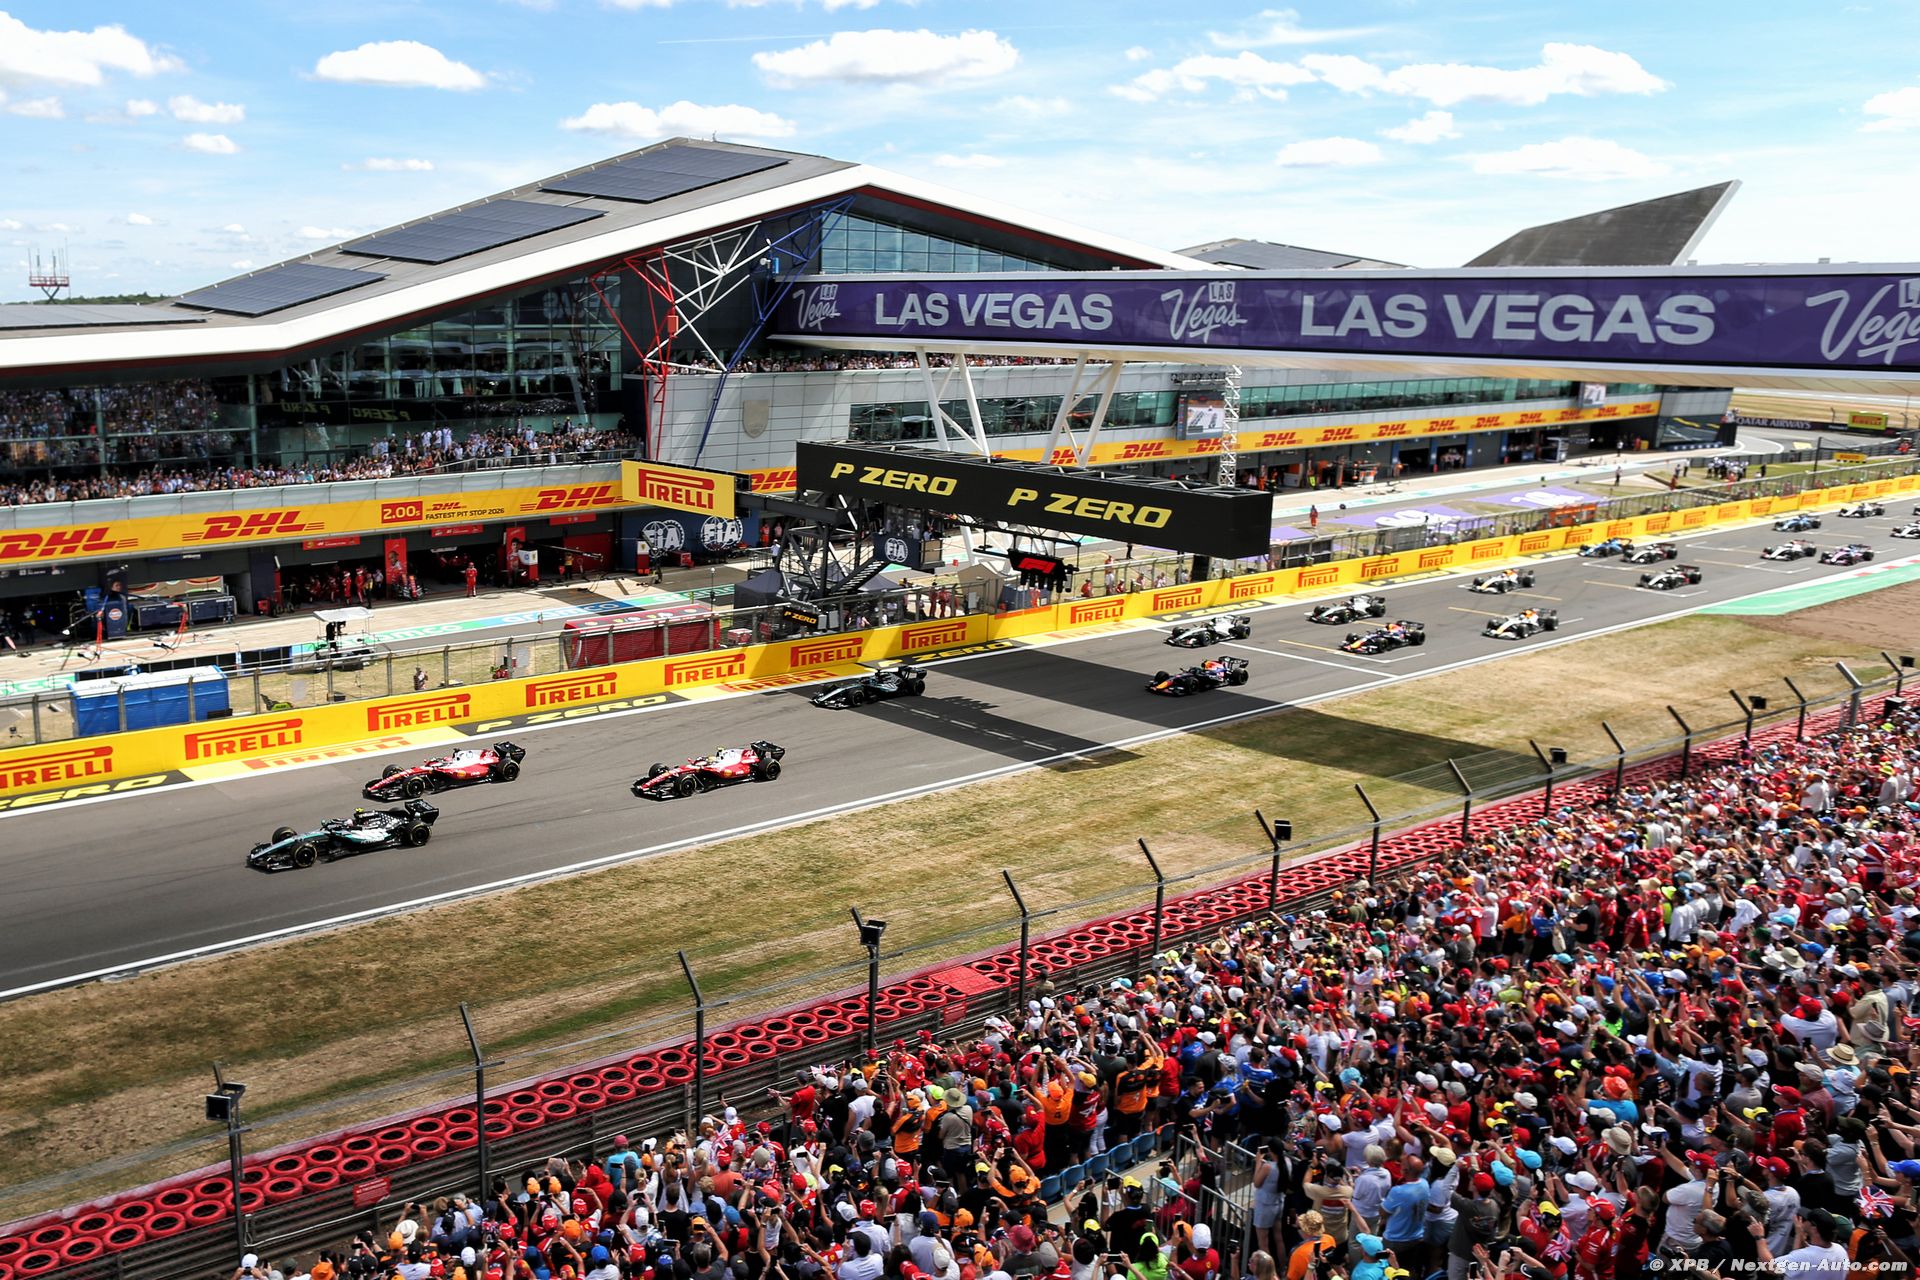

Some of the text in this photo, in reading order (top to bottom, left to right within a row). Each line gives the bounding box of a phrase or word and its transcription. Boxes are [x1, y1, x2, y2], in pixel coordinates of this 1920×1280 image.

[820, 284, 838, 300] LAS
[1209, 281, 1235, 302] LAS
[793, 285, 841, 331] Vegas
[876, 292, 1113, 330] LAS VEGAS
[1161, 286, 1248, 343] Vegas
[1300, 295, 1715, 345] LAS VEGAS
[1805, 284, 1920, 365] Veg
[1262, 432, 1297, 446] DHL
[1323, 428, 1354, 441] DHL
[1378, 424, 1407, 436] DHL
[1428, 420, 1456, 432] DHL
[1123, 442, 1166, 458] DHL
[638, 469, 715, 510] PIRELLI
[831, 463, 957, 496] P ZERO
[432, 502, 462, 510] DHL
[535, 486, 615, 510] DHL
[1007, 488, 1173, 528] P ZERO
[203, 511, 306, 539] DHL
[383, 506, 421, 520] 2.00s
[426, 511, 456, 520] FASTEST
[470, 509, 487, 517] STOP
[0, 527, 117, 558] DHL
[1361, 558, 1399, 577] PIRELLI
[1419, 550, 1454, 568] PIRELLI
[1229, 577, 1274, 599] PIRELLI
[1298, 567, 1339, 587] PIRELLI
[1070, 599, 1124, 624] PIRELLI
[1153, 588, 1202, 611] PIRELLI
[792, 613, 817, 624] ZERO
[902, 622, 967, 650] PIRELLI
[790, 637, 864, 667] PIRELLI
[664, 653, 745, 686] PIRELLI
[526, 672, 617, 707] PIRELLI
[368, 693, 471, 731] PIRELLI
[476, 695, 667, 733] P ZERO
[185, 718, 303, 760] PIRELLI
[0, 774, 168, 809] ERO
